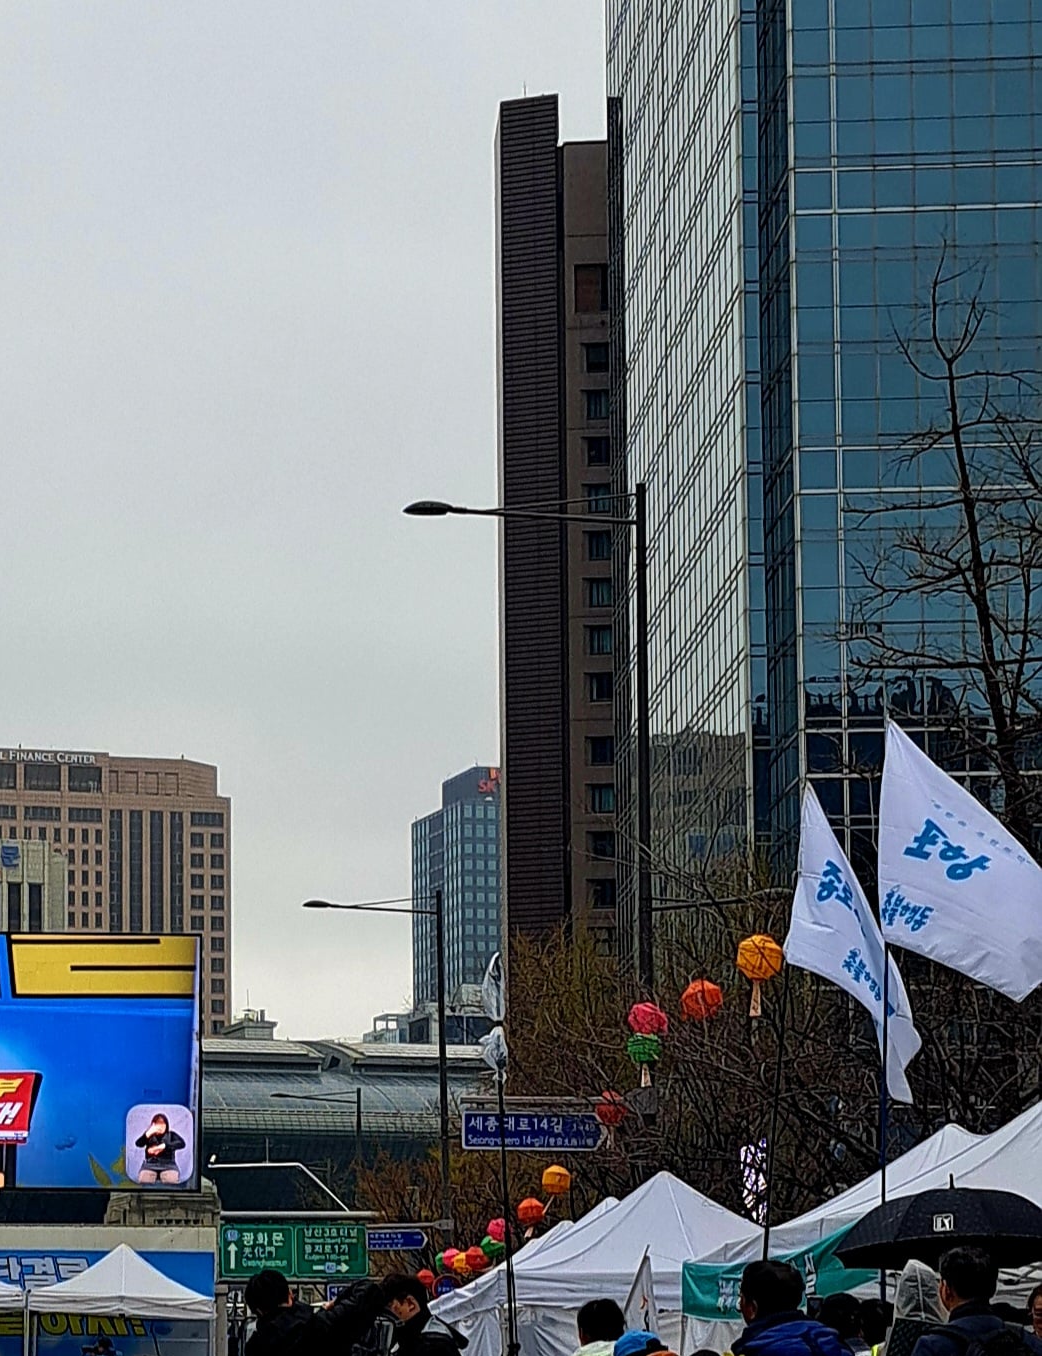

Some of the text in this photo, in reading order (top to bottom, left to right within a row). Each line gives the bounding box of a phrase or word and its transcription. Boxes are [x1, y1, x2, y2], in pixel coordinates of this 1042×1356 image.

[9, 750, 54, 762] FINANCE
[57, 752, 96, 765] CENTER
[478, 780, 496, 793] SK
[902, 818, 992, 881] 포항
[468, 1116, 563, 1133] 세종대로14길
[241, 1231, 286, 1246] 광화문
